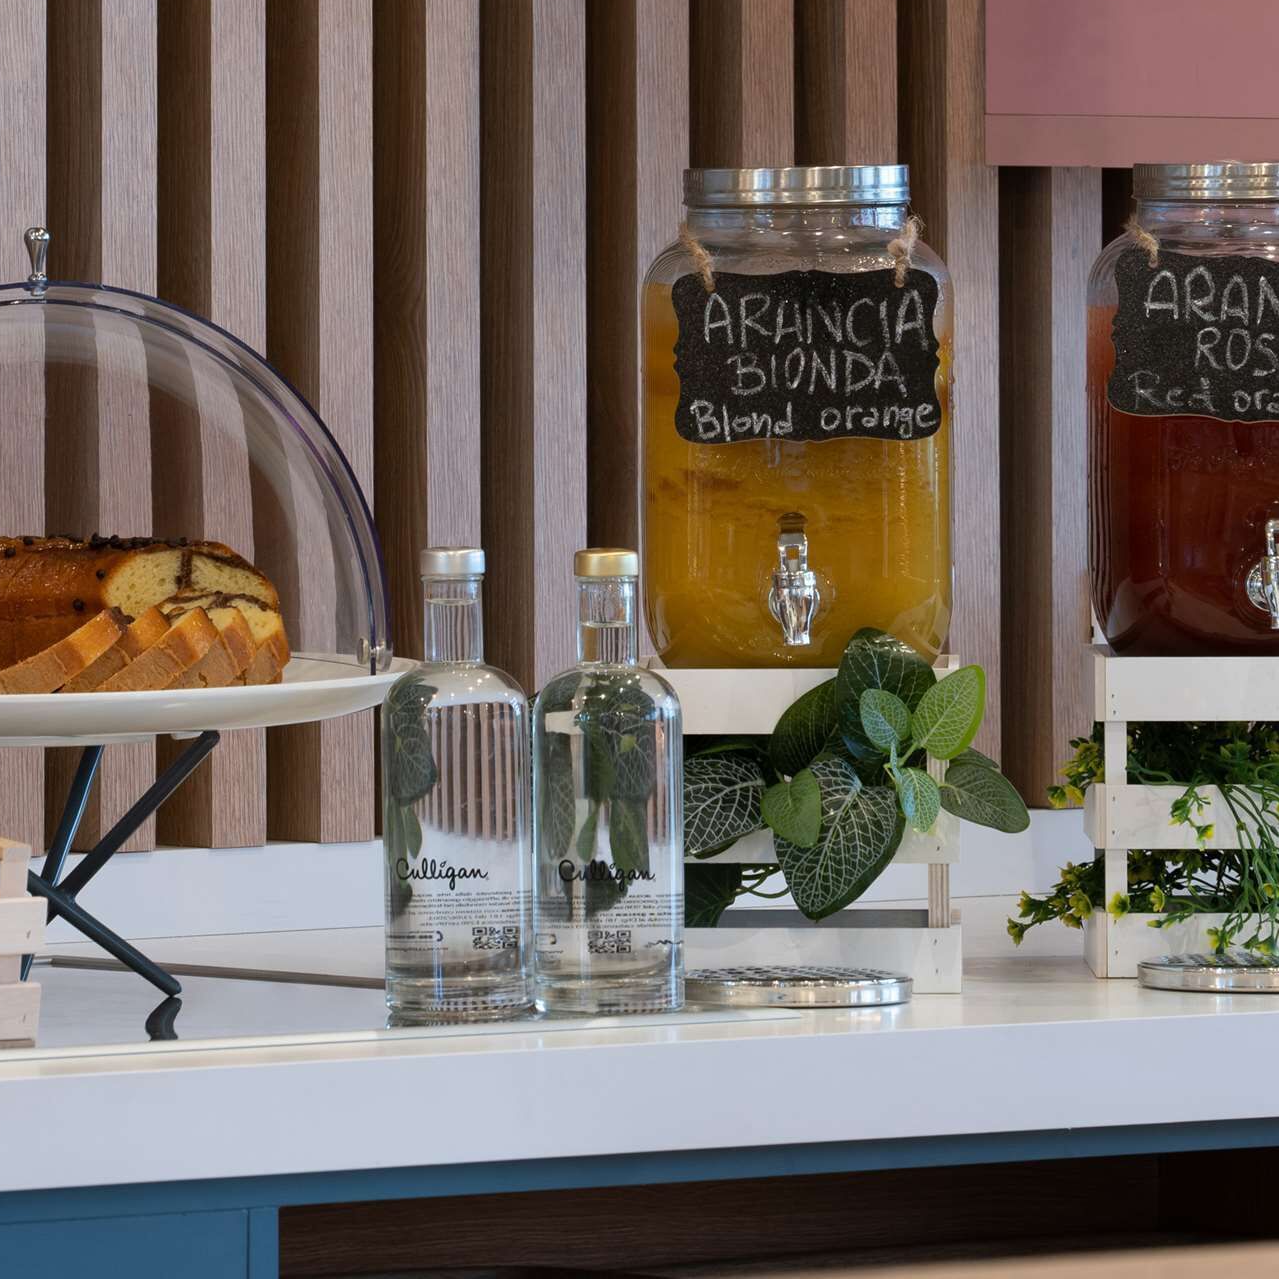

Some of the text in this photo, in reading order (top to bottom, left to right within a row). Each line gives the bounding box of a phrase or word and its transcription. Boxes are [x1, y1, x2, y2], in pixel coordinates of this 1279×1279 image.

[703, 288, 929, 351] ARANCIA
[725, 346, 908, 398] BIONDA
[689, 399, 937, 442] Blond orange
[396, 857, 488, 891] Culligan
[559, 859, 656, 892] Culligan
